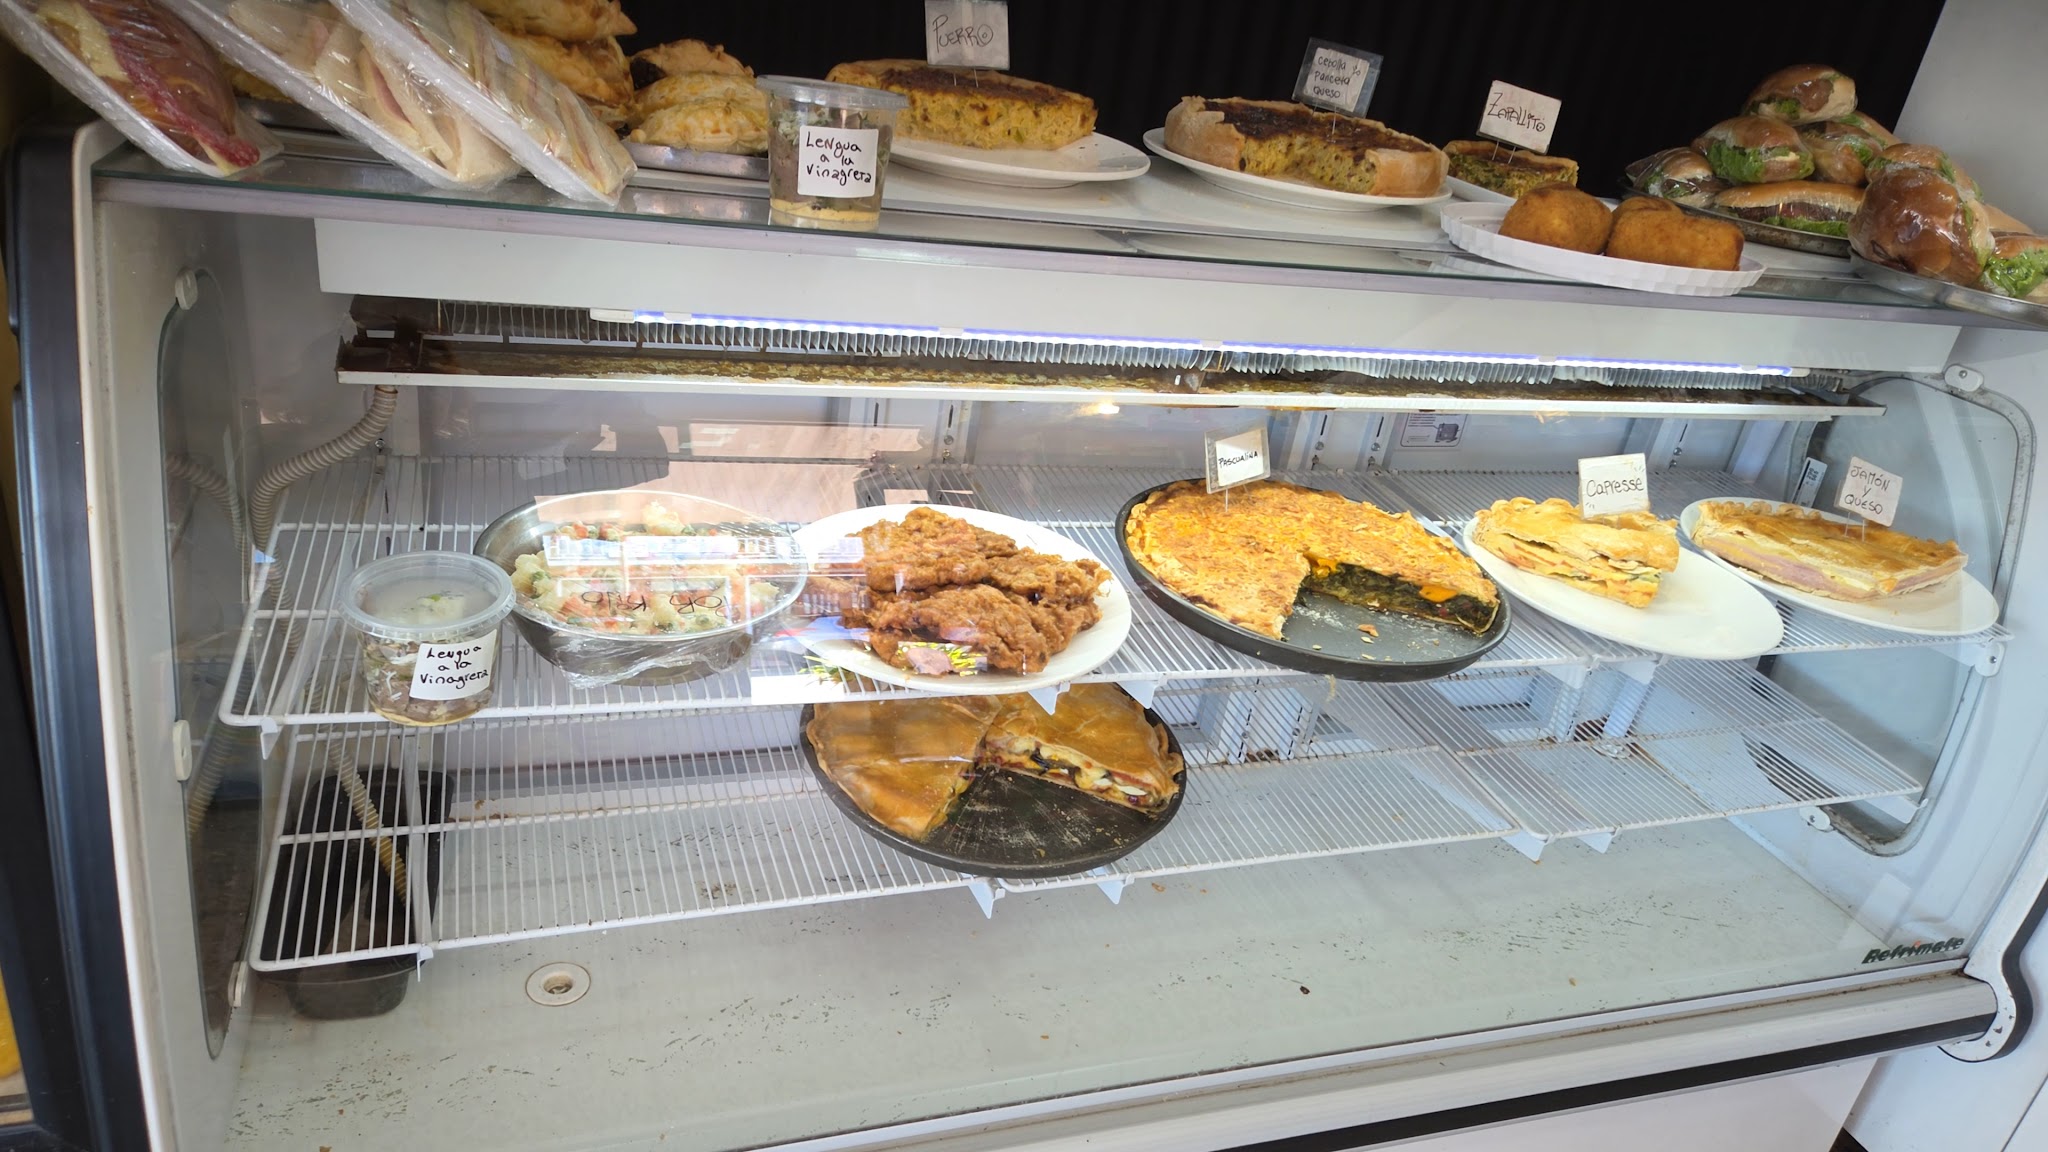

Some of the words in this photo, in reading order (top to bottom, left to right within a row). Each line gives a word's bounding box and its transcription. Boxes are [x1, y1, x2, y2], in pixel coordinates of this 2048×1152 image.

[819, 153, 830, 163] a
[841, 155, 854, 166] la
[1850, 466, 1891, 492] JAMÓN
[1844, 494, 1884, 515] QUESO
[454, 660, 472, 670] la
[1861, 937, 1965, 964] Refrimate
